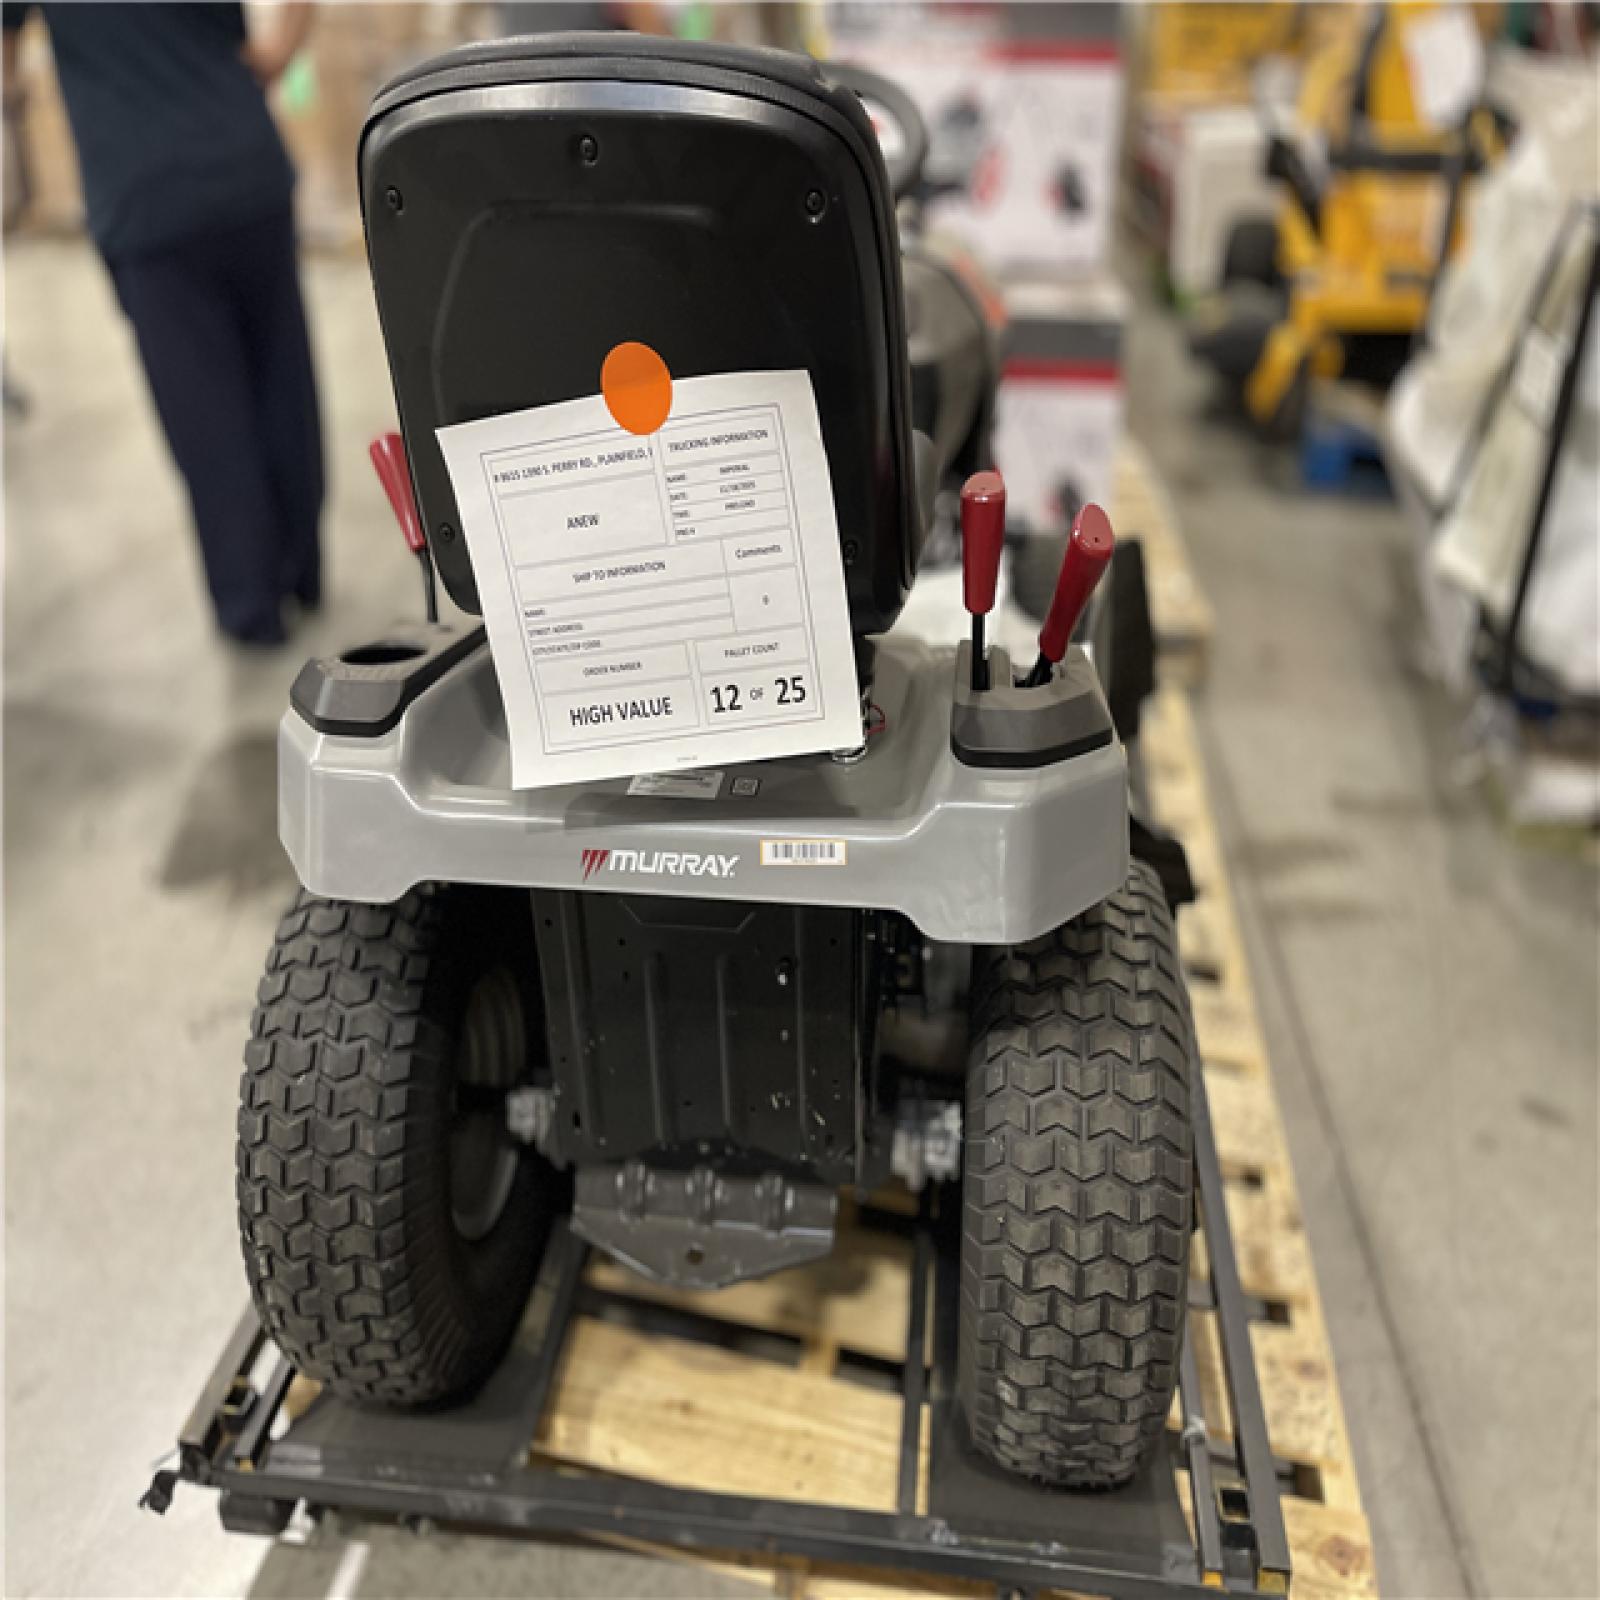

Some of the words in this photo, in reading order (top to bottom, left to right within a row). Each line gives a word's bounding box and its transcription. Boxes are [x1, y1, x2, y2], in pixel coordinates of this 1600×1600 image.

[667, 437, 708, 452] TRUCKING
[710, 429, 768, 445] INFORMATION
[552, 460, 578, 472] PERRY
[566, 514, 600, 529] ANEW
[735, 544, 782, 558] Comments
[572, 572, 591, 584] SHIP
[593, 570, 606, 580] TO
[607, 560, 666, 578] INFORMATION
[724, 646, 750, 658] PALLET
[752, 642, 779, 656] COUNT
[582, 666, 608, 677] ORDER
[610, 661, 643, 674] NUMBER
[710, 684, 743, 713] 12
[774, 674, 806, 706] 25
[570, 704, 614, 726] HIGH
[615, 696, 673, 721] VALUE
[608, 850, 741, 879] MURRAY
